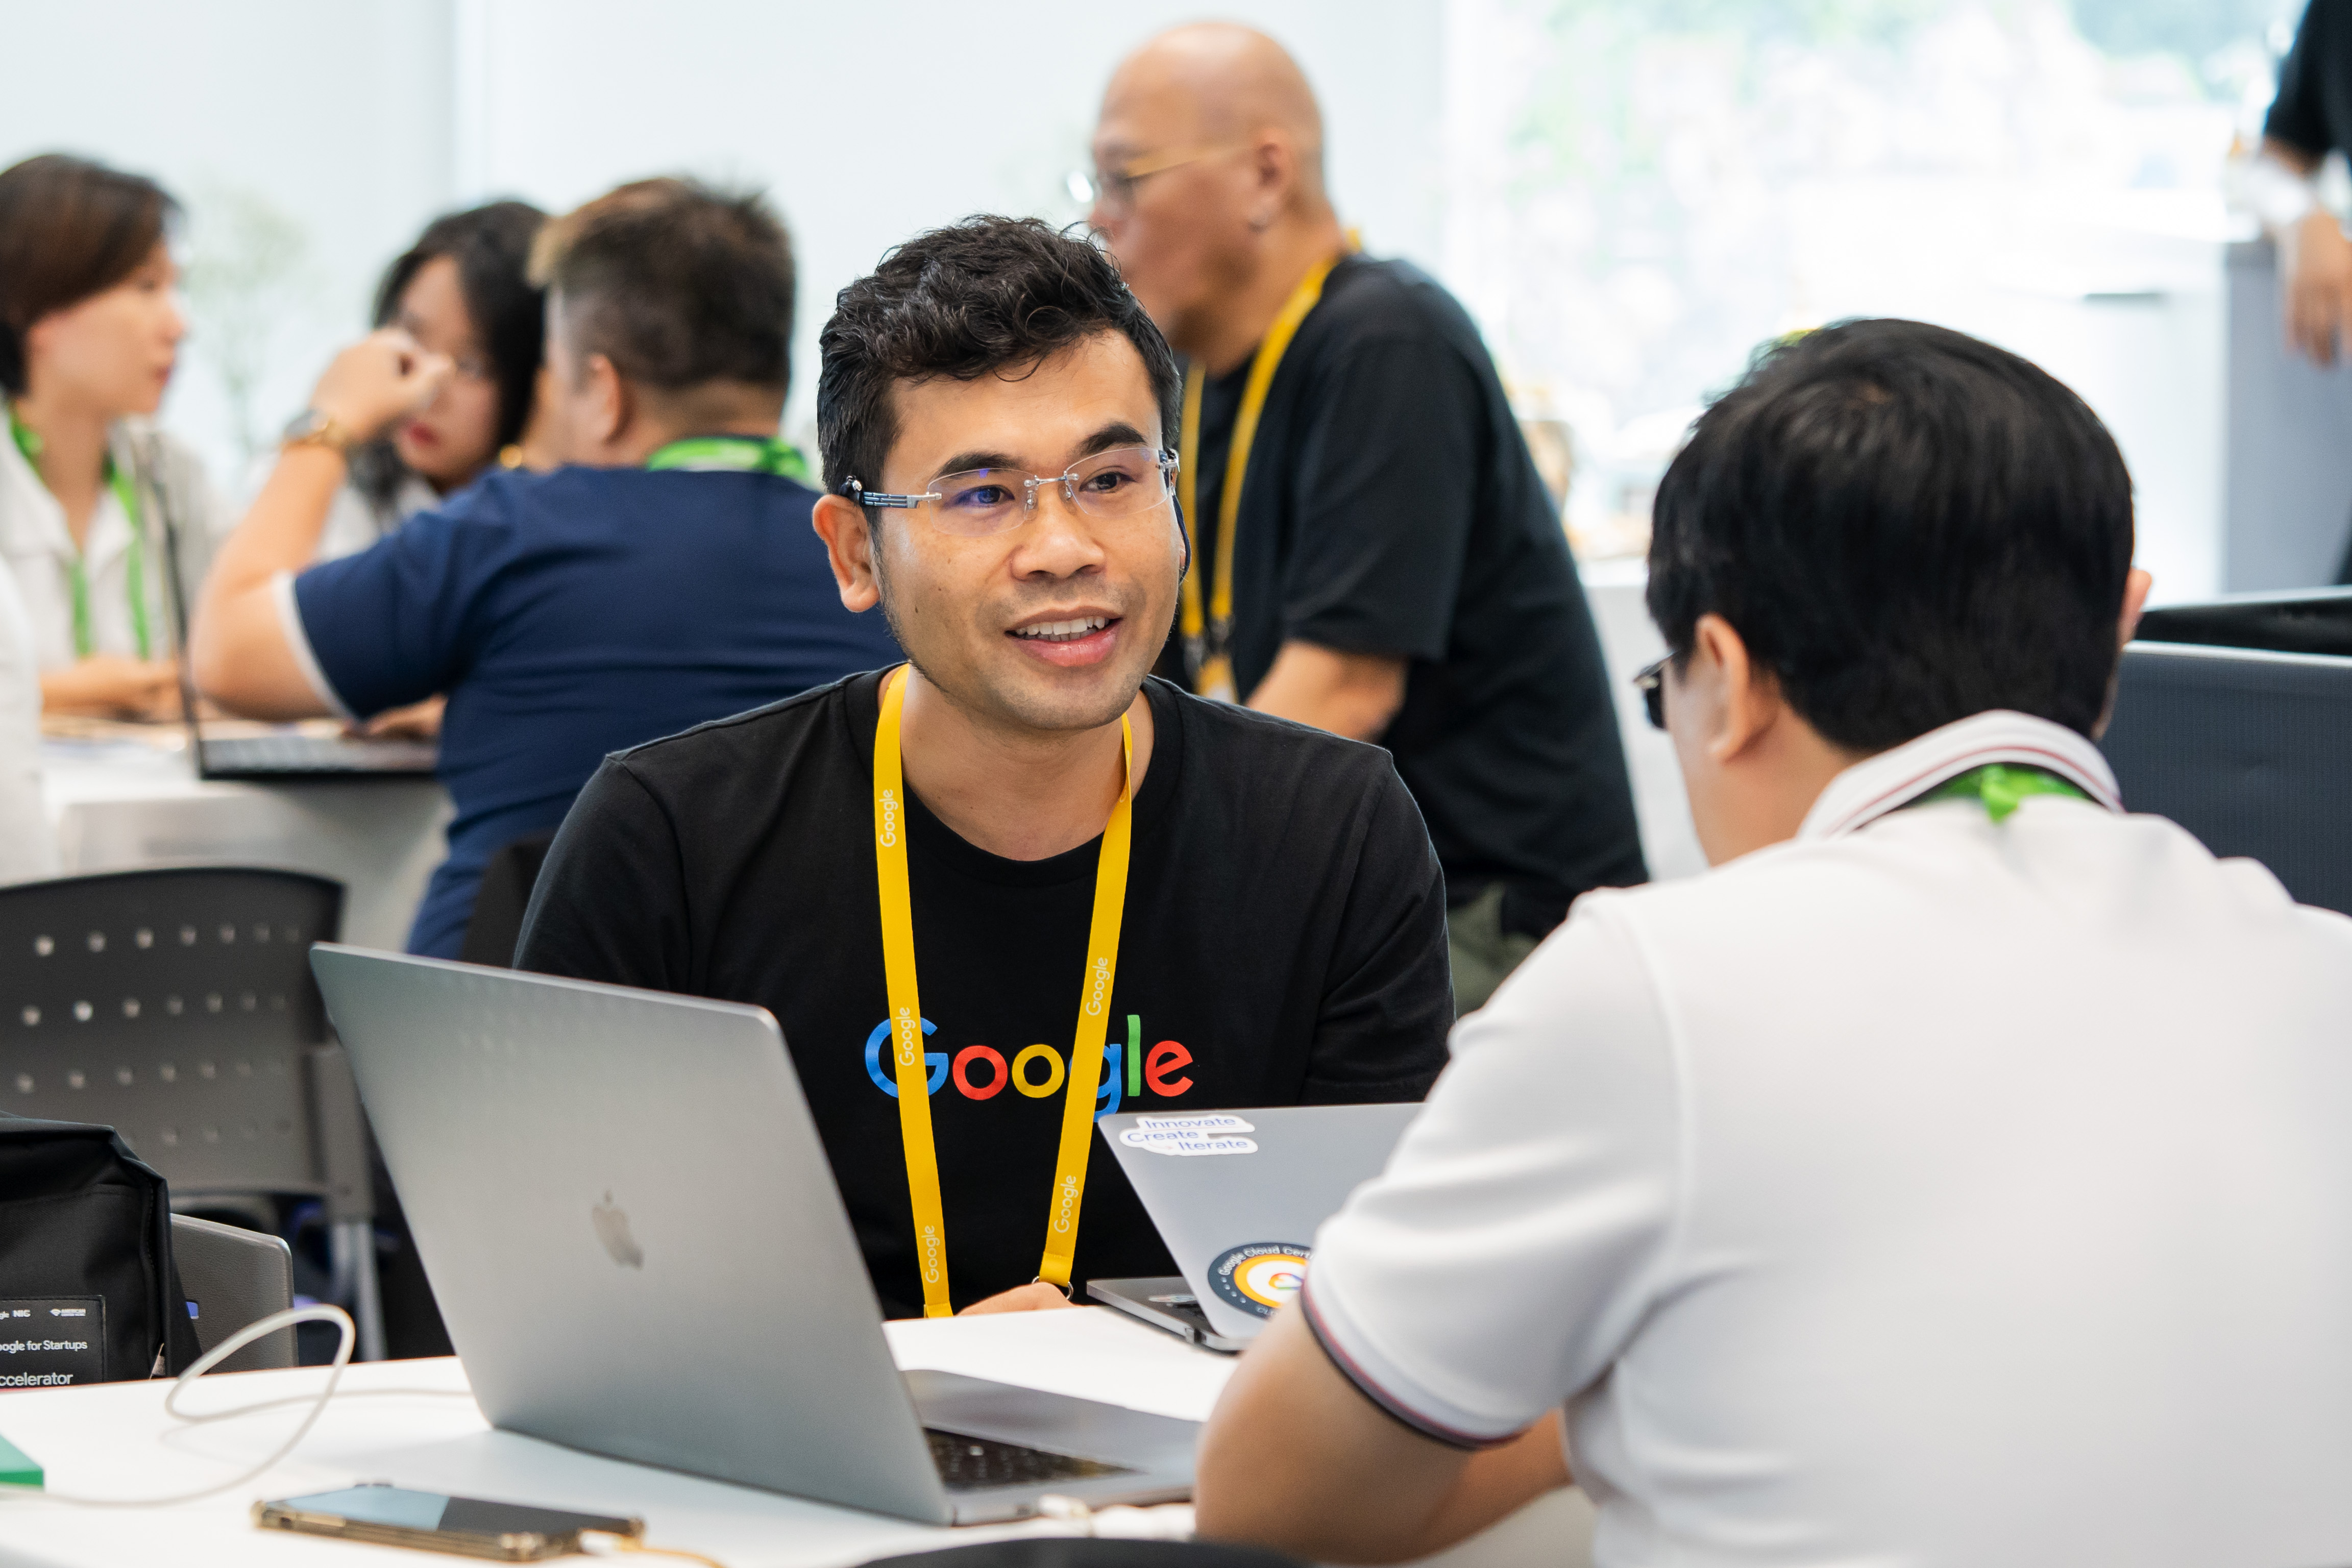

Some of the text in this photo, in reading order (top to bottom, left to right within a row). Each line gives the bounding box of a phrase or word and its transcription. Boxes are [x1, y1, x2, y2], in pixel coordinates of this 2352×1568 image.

[879, 789, 898, 847] Google
[1085, 957, 1111, 1016] Google
[895, 1007, 916, 1066] Google
[1127, 1130, 1199, 1142] Create
[1145, 1117, 1236, 1129] Innovate
[1178, 1140, 1248, 1151] Iterate
[1054, 1175, 1079, 1233] Google
[921, 1225, 940, 1284] Google
[1217, 1252, 1246, 1276] Google
[1243, 1245, 1280, 1257] Cloud
[27, 1340, 42, 1351] for
[43, 1339, 88, 1352] Startups
